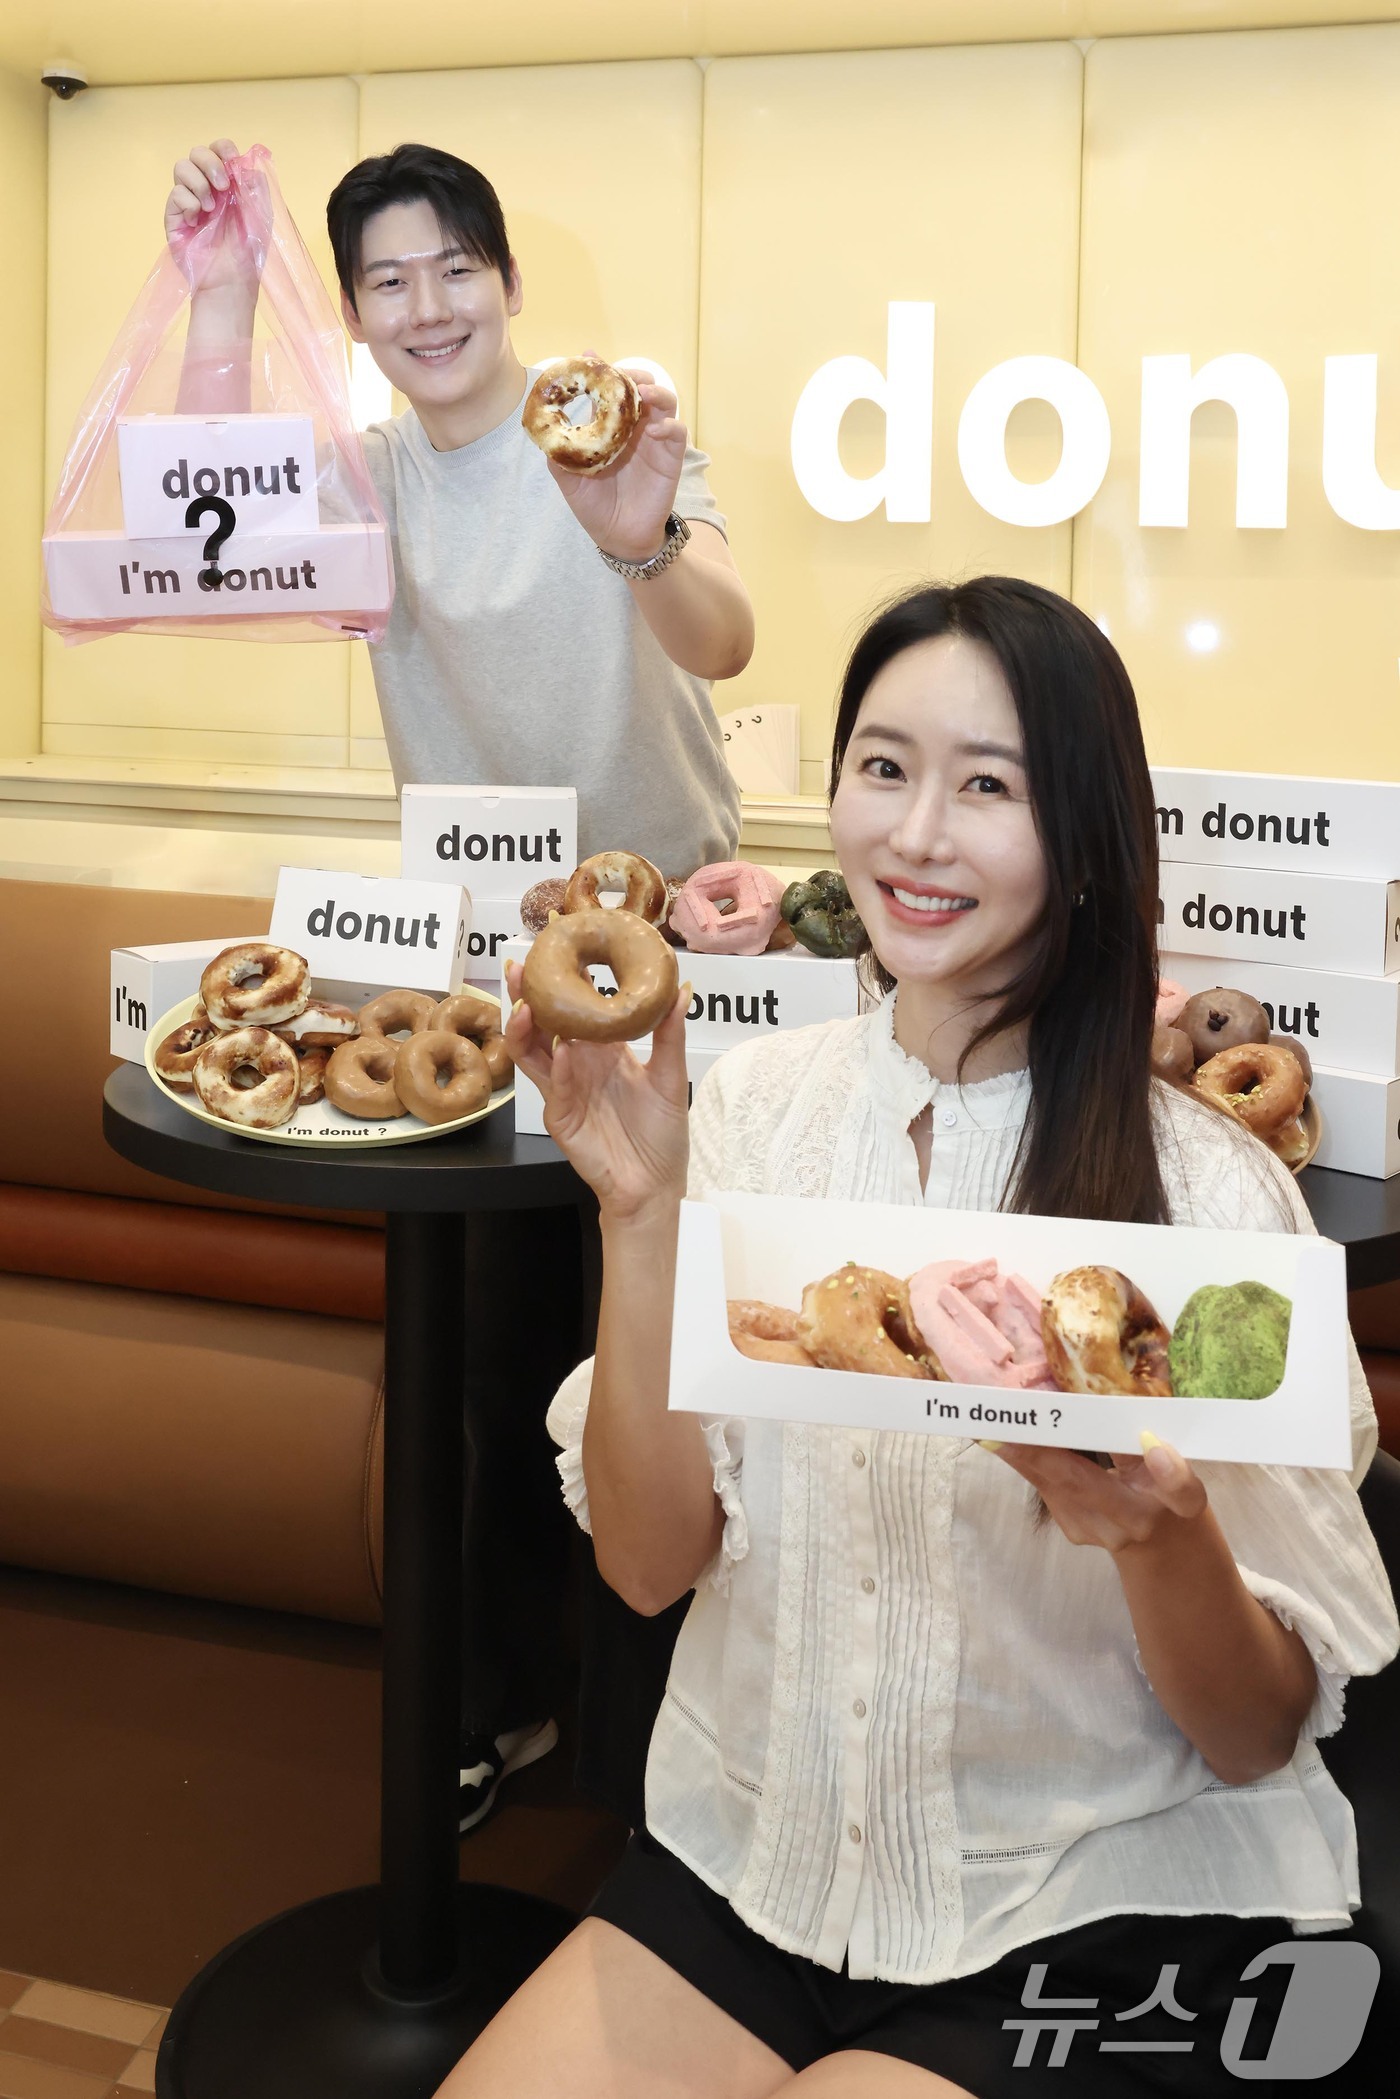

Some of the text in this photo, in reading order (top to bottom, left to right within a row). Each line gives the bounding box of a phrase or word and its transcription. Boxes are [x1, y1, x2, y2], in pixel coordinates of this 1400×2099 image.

[162, 457, 301, 499] donut
[184, 495, 237, 587] ?
[119, 561, 181, 594] I'm
[436, 824, 562, 863] donut
[1201, 803, 1330, 847] donut
[307, 899, 441, 950] donut
[1182, 893, 1306, 941] donut
[458, 919, 465, 959] ?
[116, 985, 147, 1031] I'm
[684, 990, 779, 1026] onut
[287, 1127, 387, 1136] I'm donut ?
[926, 1398, 1062, 1428] I'm donut ?
